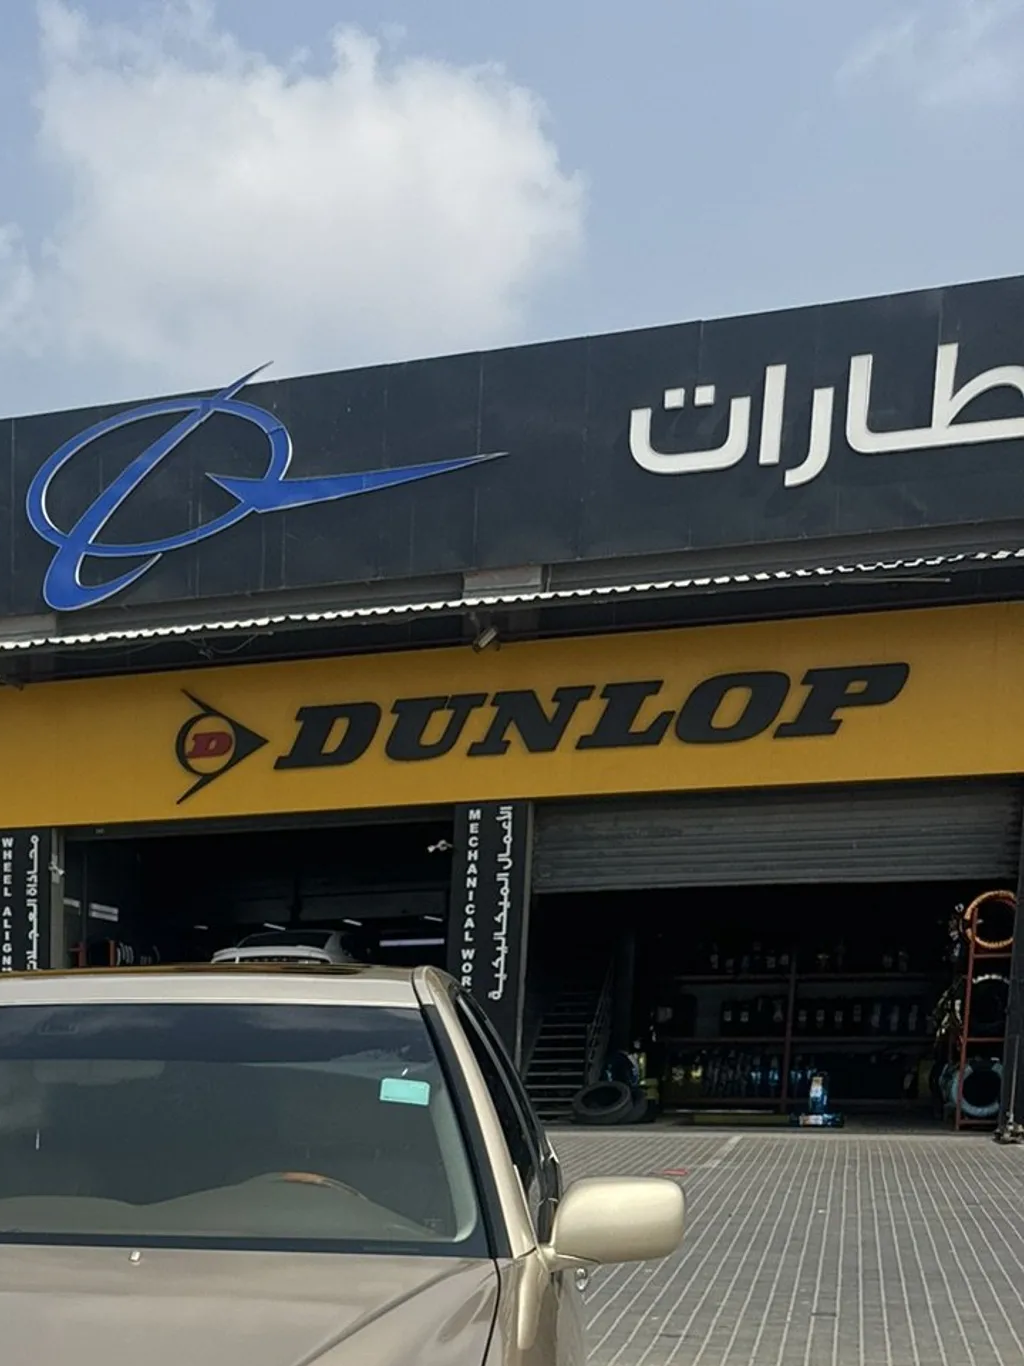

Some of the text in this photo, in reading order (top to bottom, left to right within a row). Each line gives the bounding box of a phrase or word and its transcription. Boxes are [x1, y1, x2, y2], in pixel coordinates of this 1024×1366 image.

[273, 662, 910, 770] DUNLOP
[1, 837, 14, 898] WHEEL
[461, 809, 482, 993] MECHANICAL WOR
